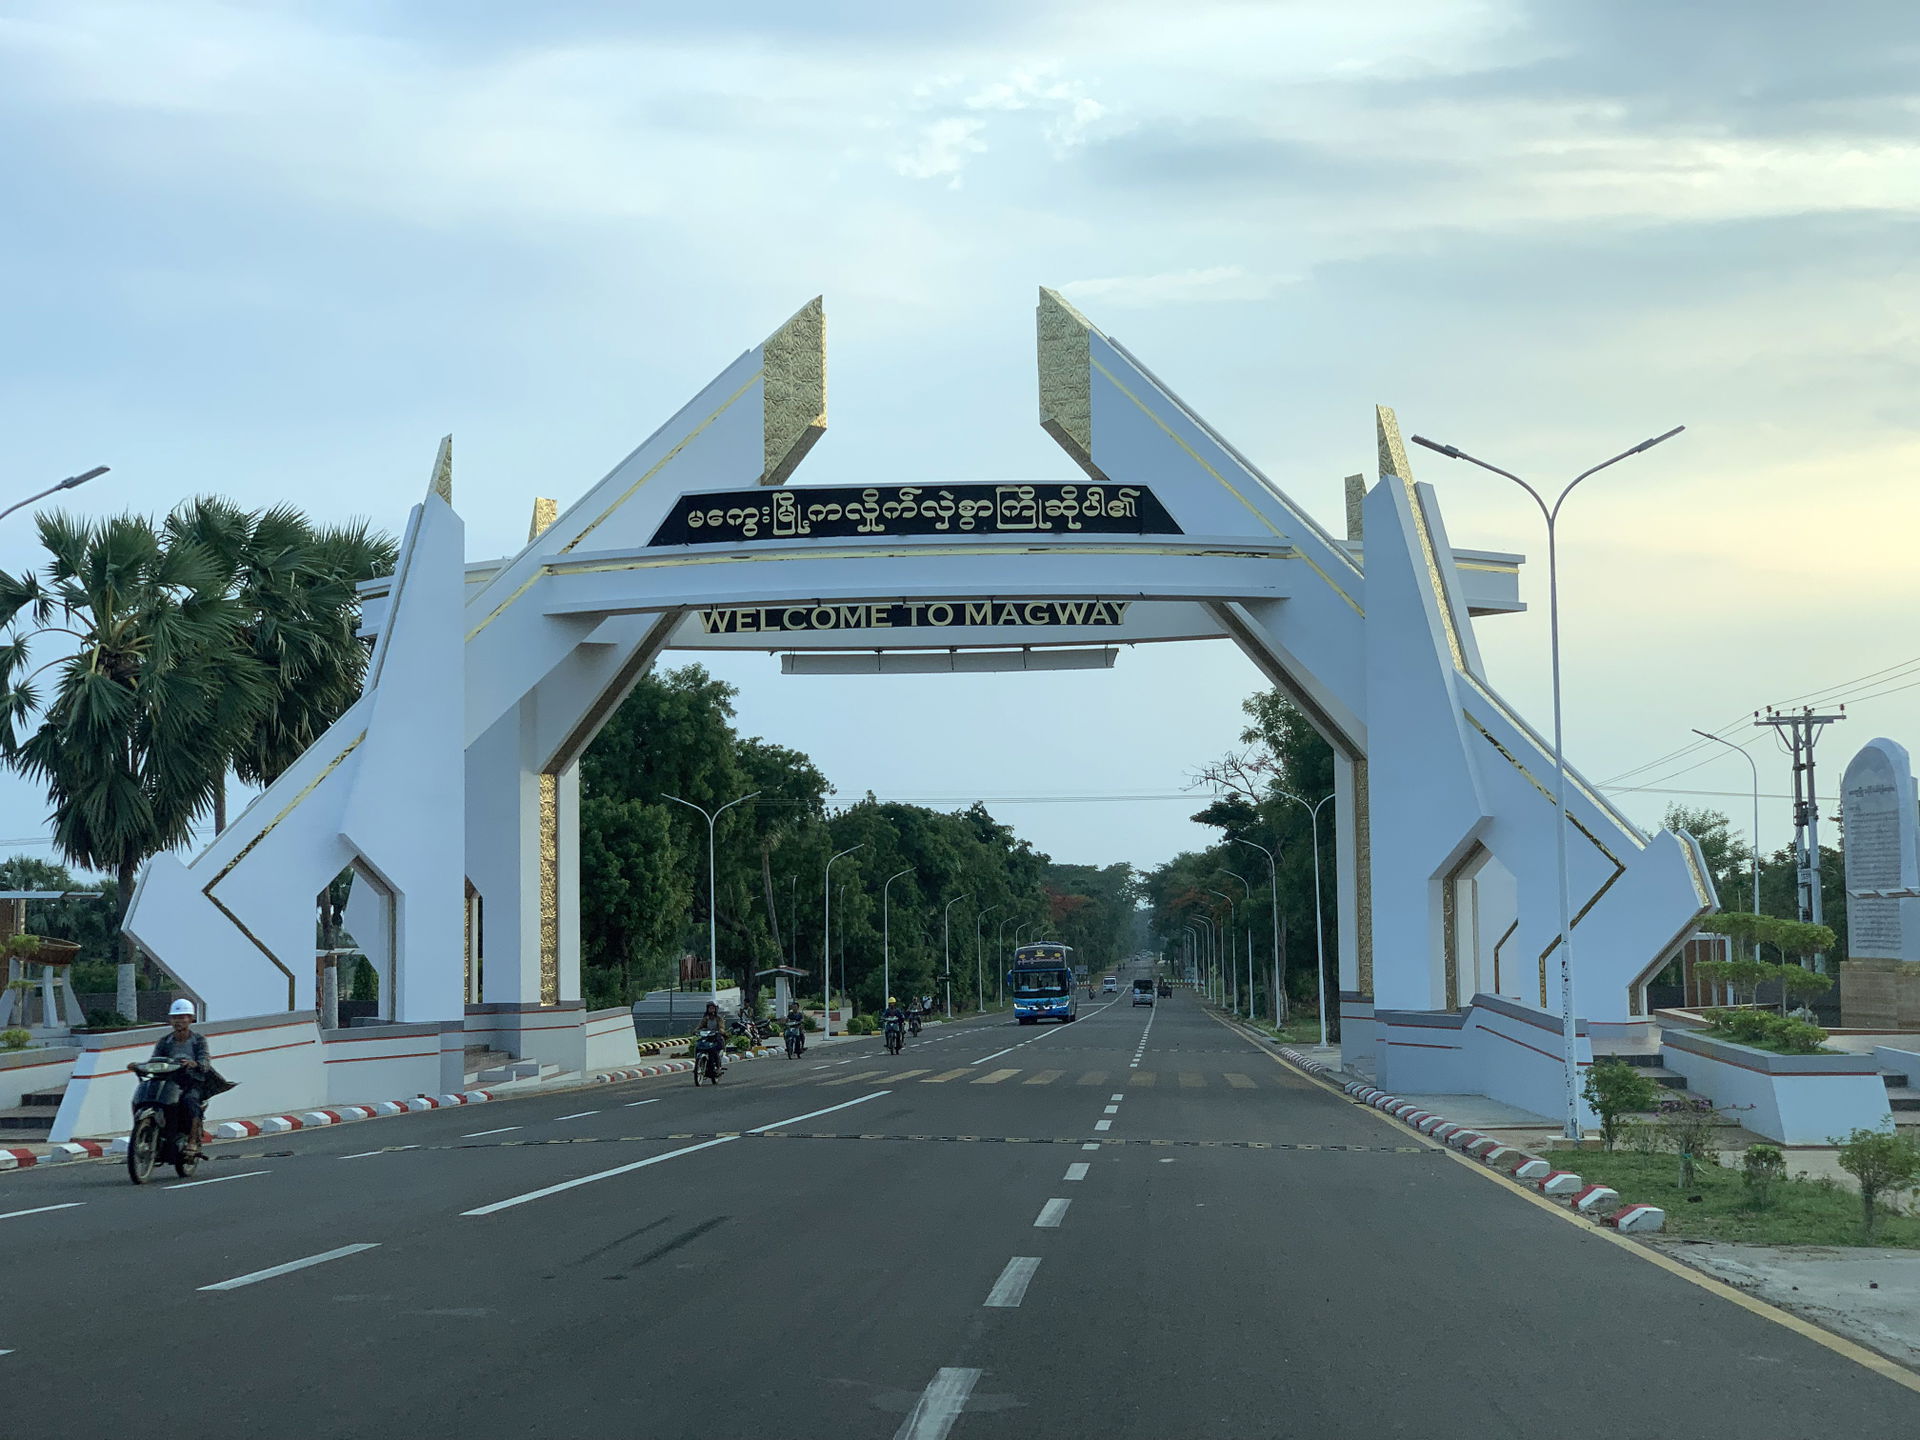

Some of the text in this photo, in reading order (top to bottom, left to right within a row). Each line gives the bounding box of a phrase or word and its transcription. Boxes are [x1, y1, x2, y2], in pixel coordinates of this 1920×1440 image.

[698, 602, 1133, 633] WELCOME TO MAGWAY
